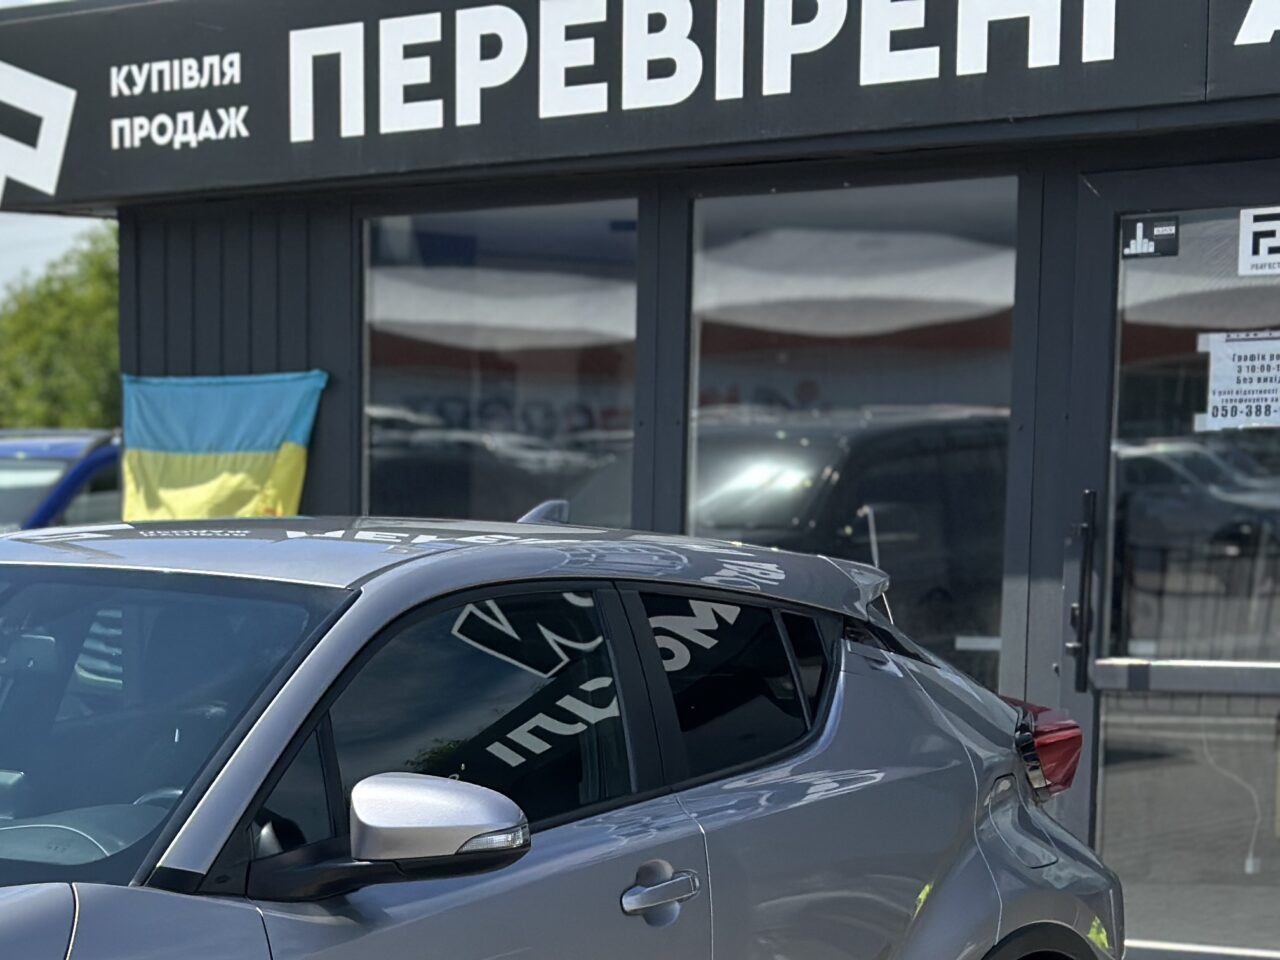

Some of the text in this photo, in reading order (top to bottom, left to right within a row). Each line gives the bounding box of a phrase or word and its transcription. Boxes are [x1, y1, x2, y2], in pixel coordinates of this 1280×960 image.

[110, 52, 241, 98] КУПІВЛЯ
[110, 105, 250, 150] ПРОДАЖ
[1211, 403, 1280, 419] 050-388-
